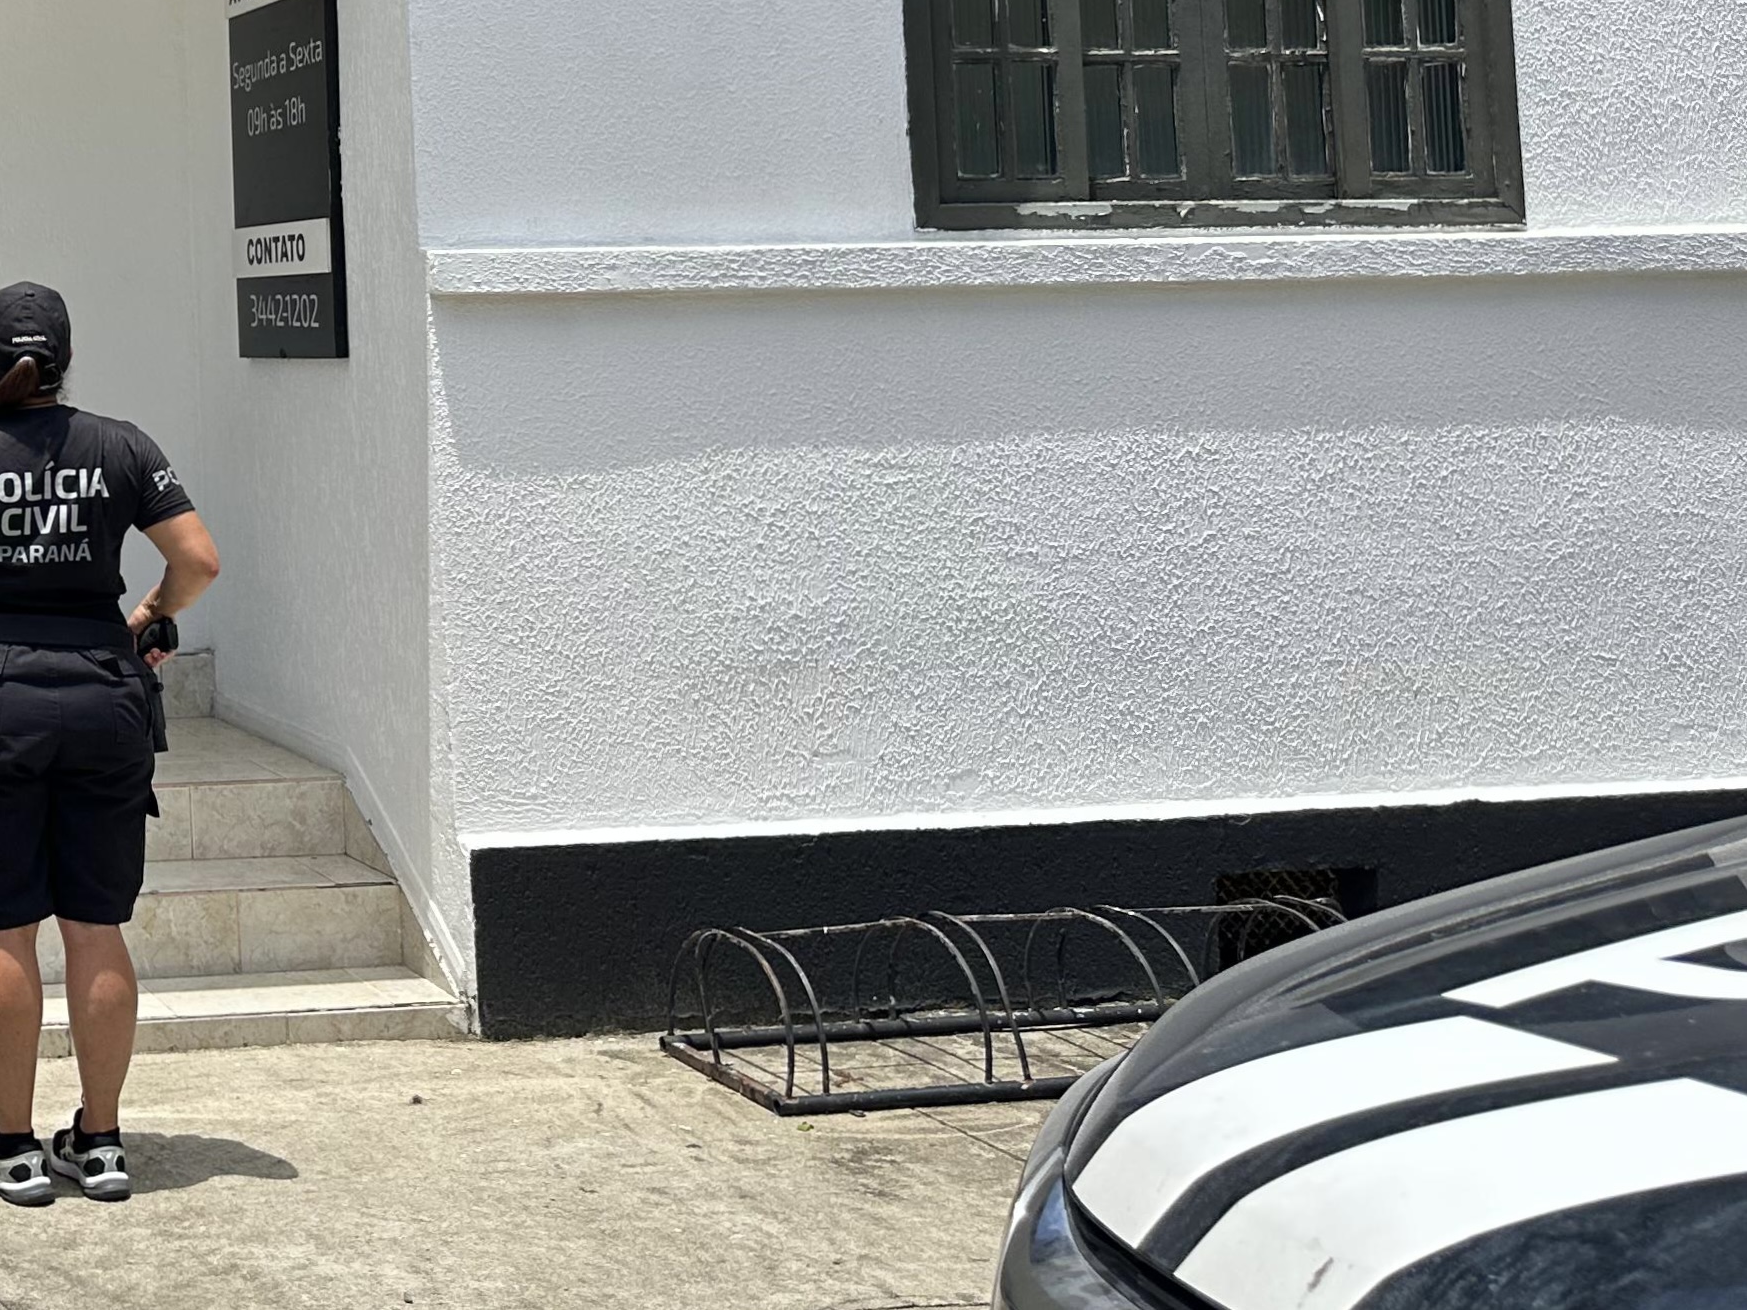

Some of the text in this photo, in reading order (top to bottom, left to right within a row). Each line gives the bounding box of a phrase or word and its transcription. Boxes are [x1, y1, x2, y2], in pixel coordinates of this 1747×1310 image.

[232, 38, 323, 92] Segunda a Sexta
[247, 95, 306, 136] 09h às 18h
[247, 233, 306, 266] CONTATO
[249, 294, 320, 328] 3442-1202
[0, 503, 88, 537] CIVIL
